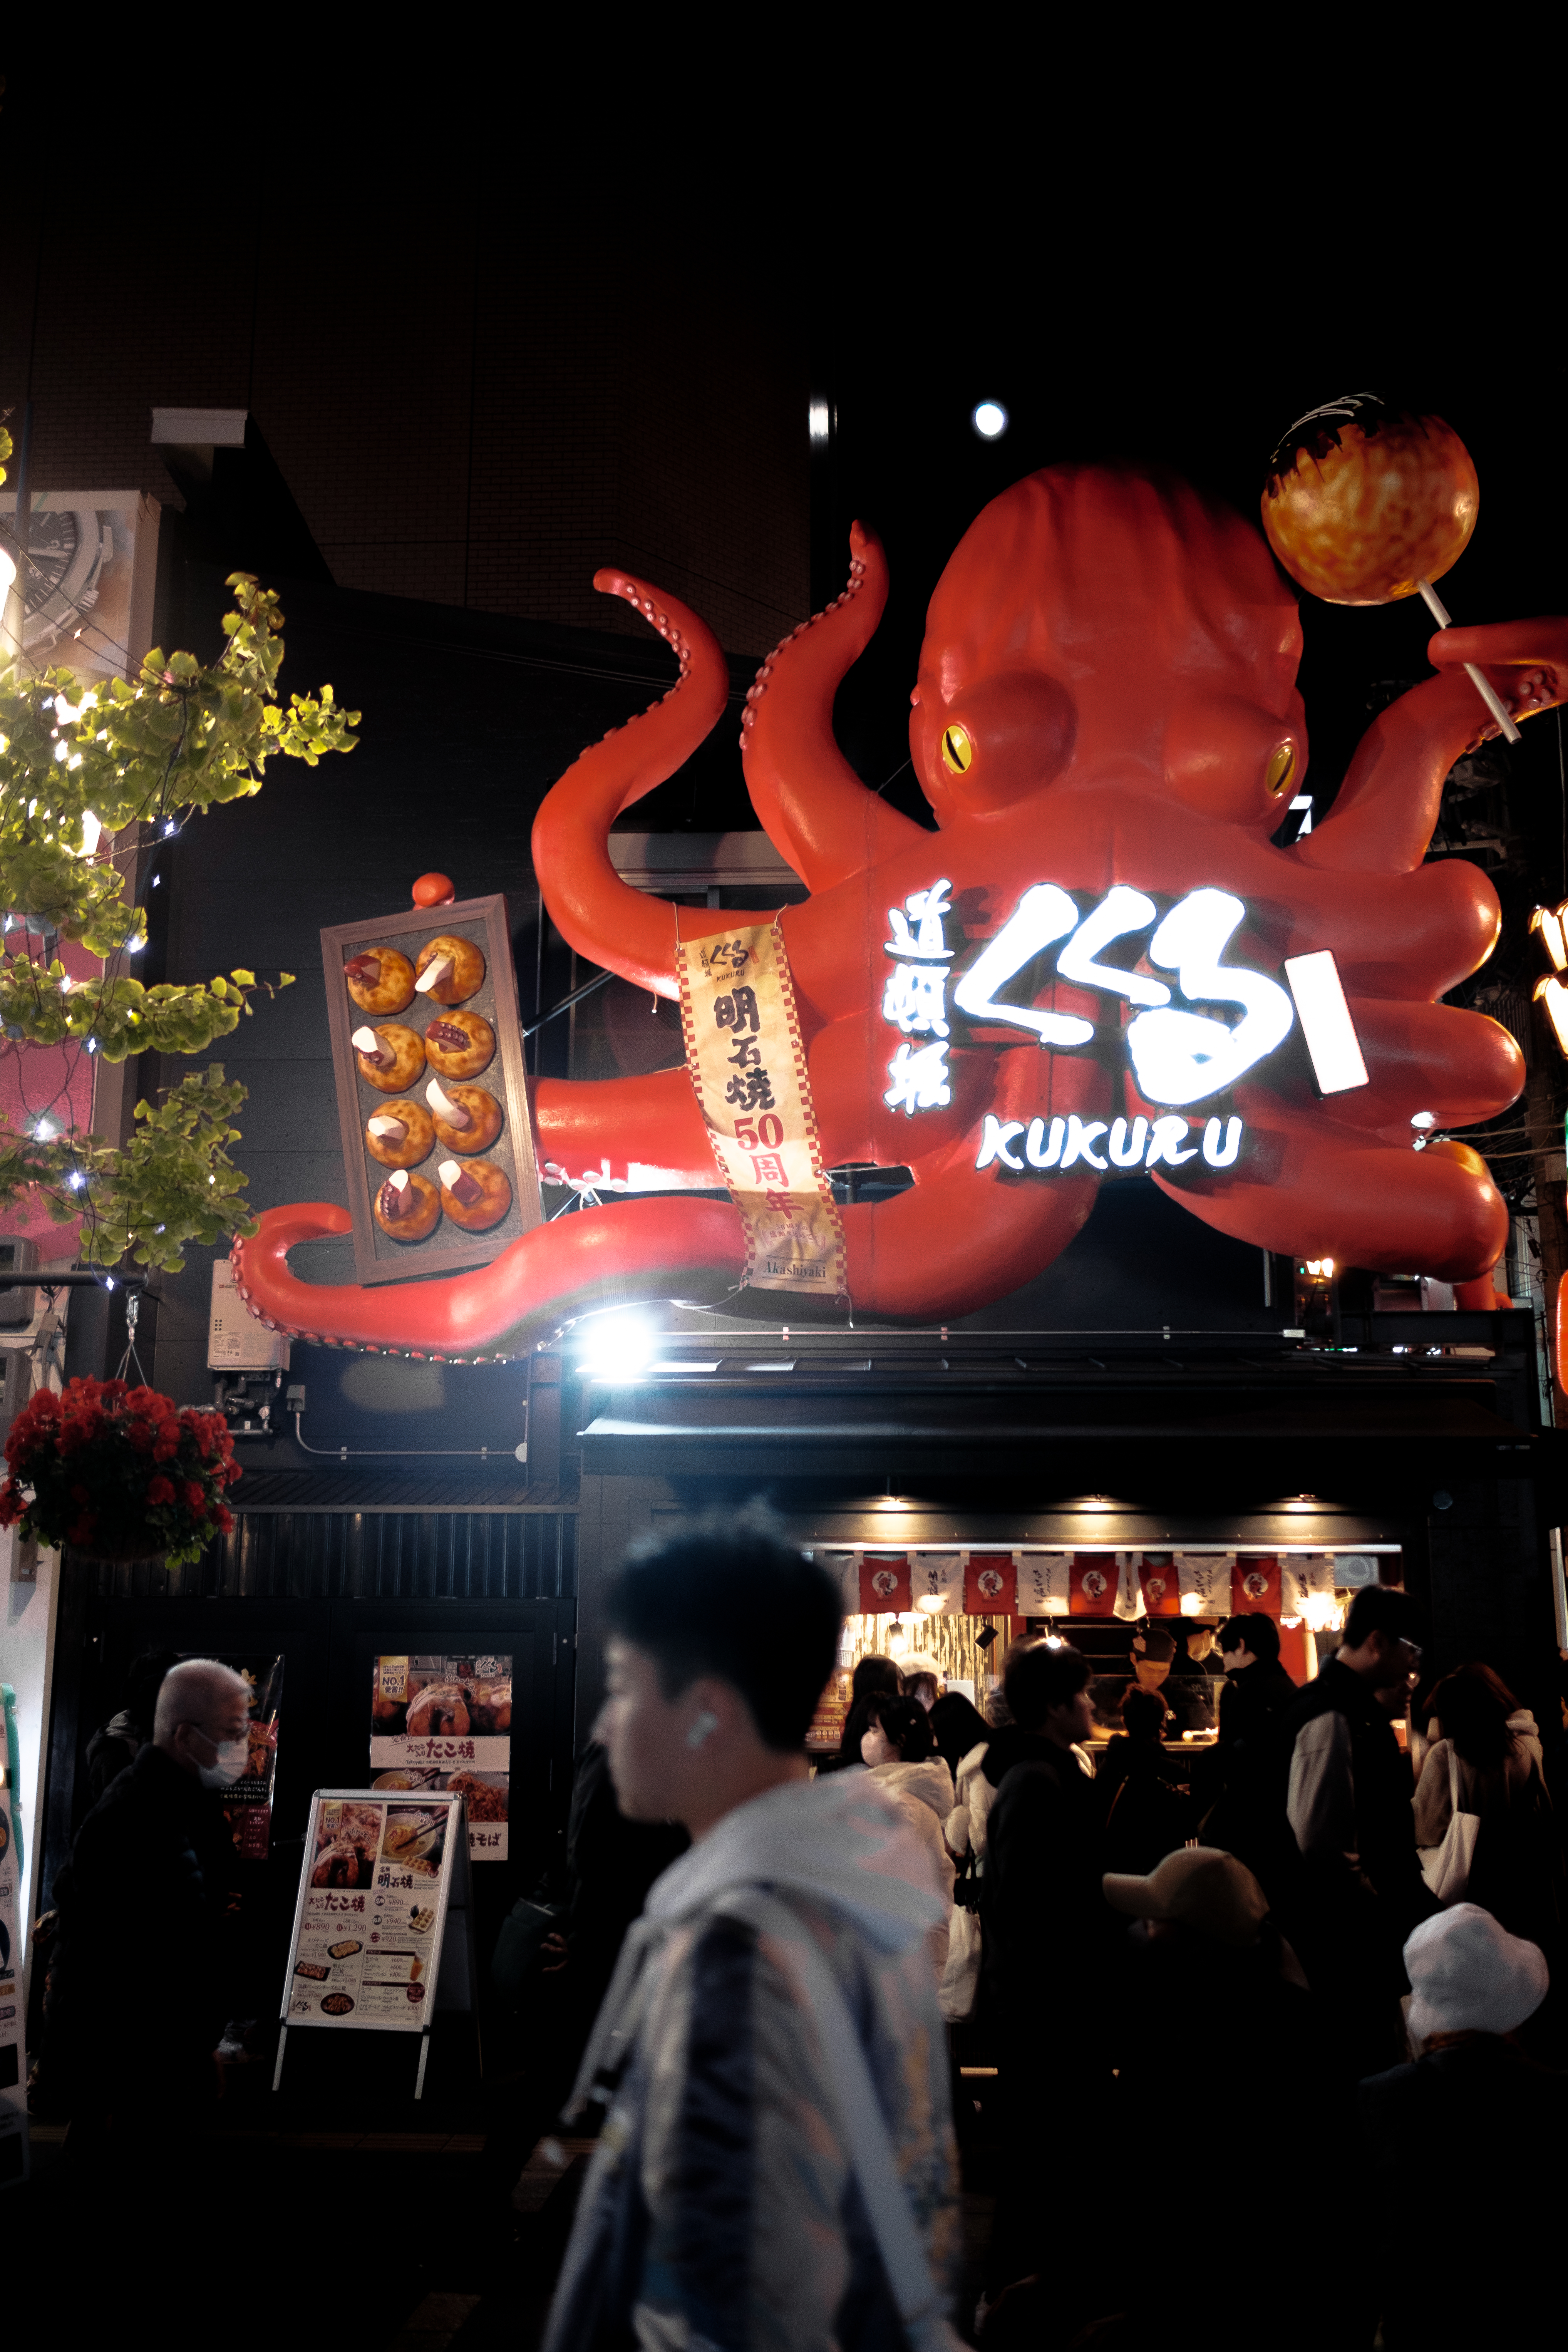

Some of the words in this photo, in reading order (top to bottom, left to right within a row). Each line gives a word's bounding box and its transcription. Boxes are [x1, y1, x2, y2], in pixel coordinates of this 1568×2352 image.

[710, 940, 749, 968] くくる
[717, 970, 745, 982] KUKURU
[954, 883, 1293, 1106] くくる
[977, 1115, 1242, 1170] KUKURU
[763, 1261, 826, 1278] Akashiyaki
[382, 1675, 405, 1685] NO.1
[427, 1738, 475, 1759] たこ焼
[378, 1873, 413, 1889] 明石焼
[325, 1892, 365, 1912] たこ焼
